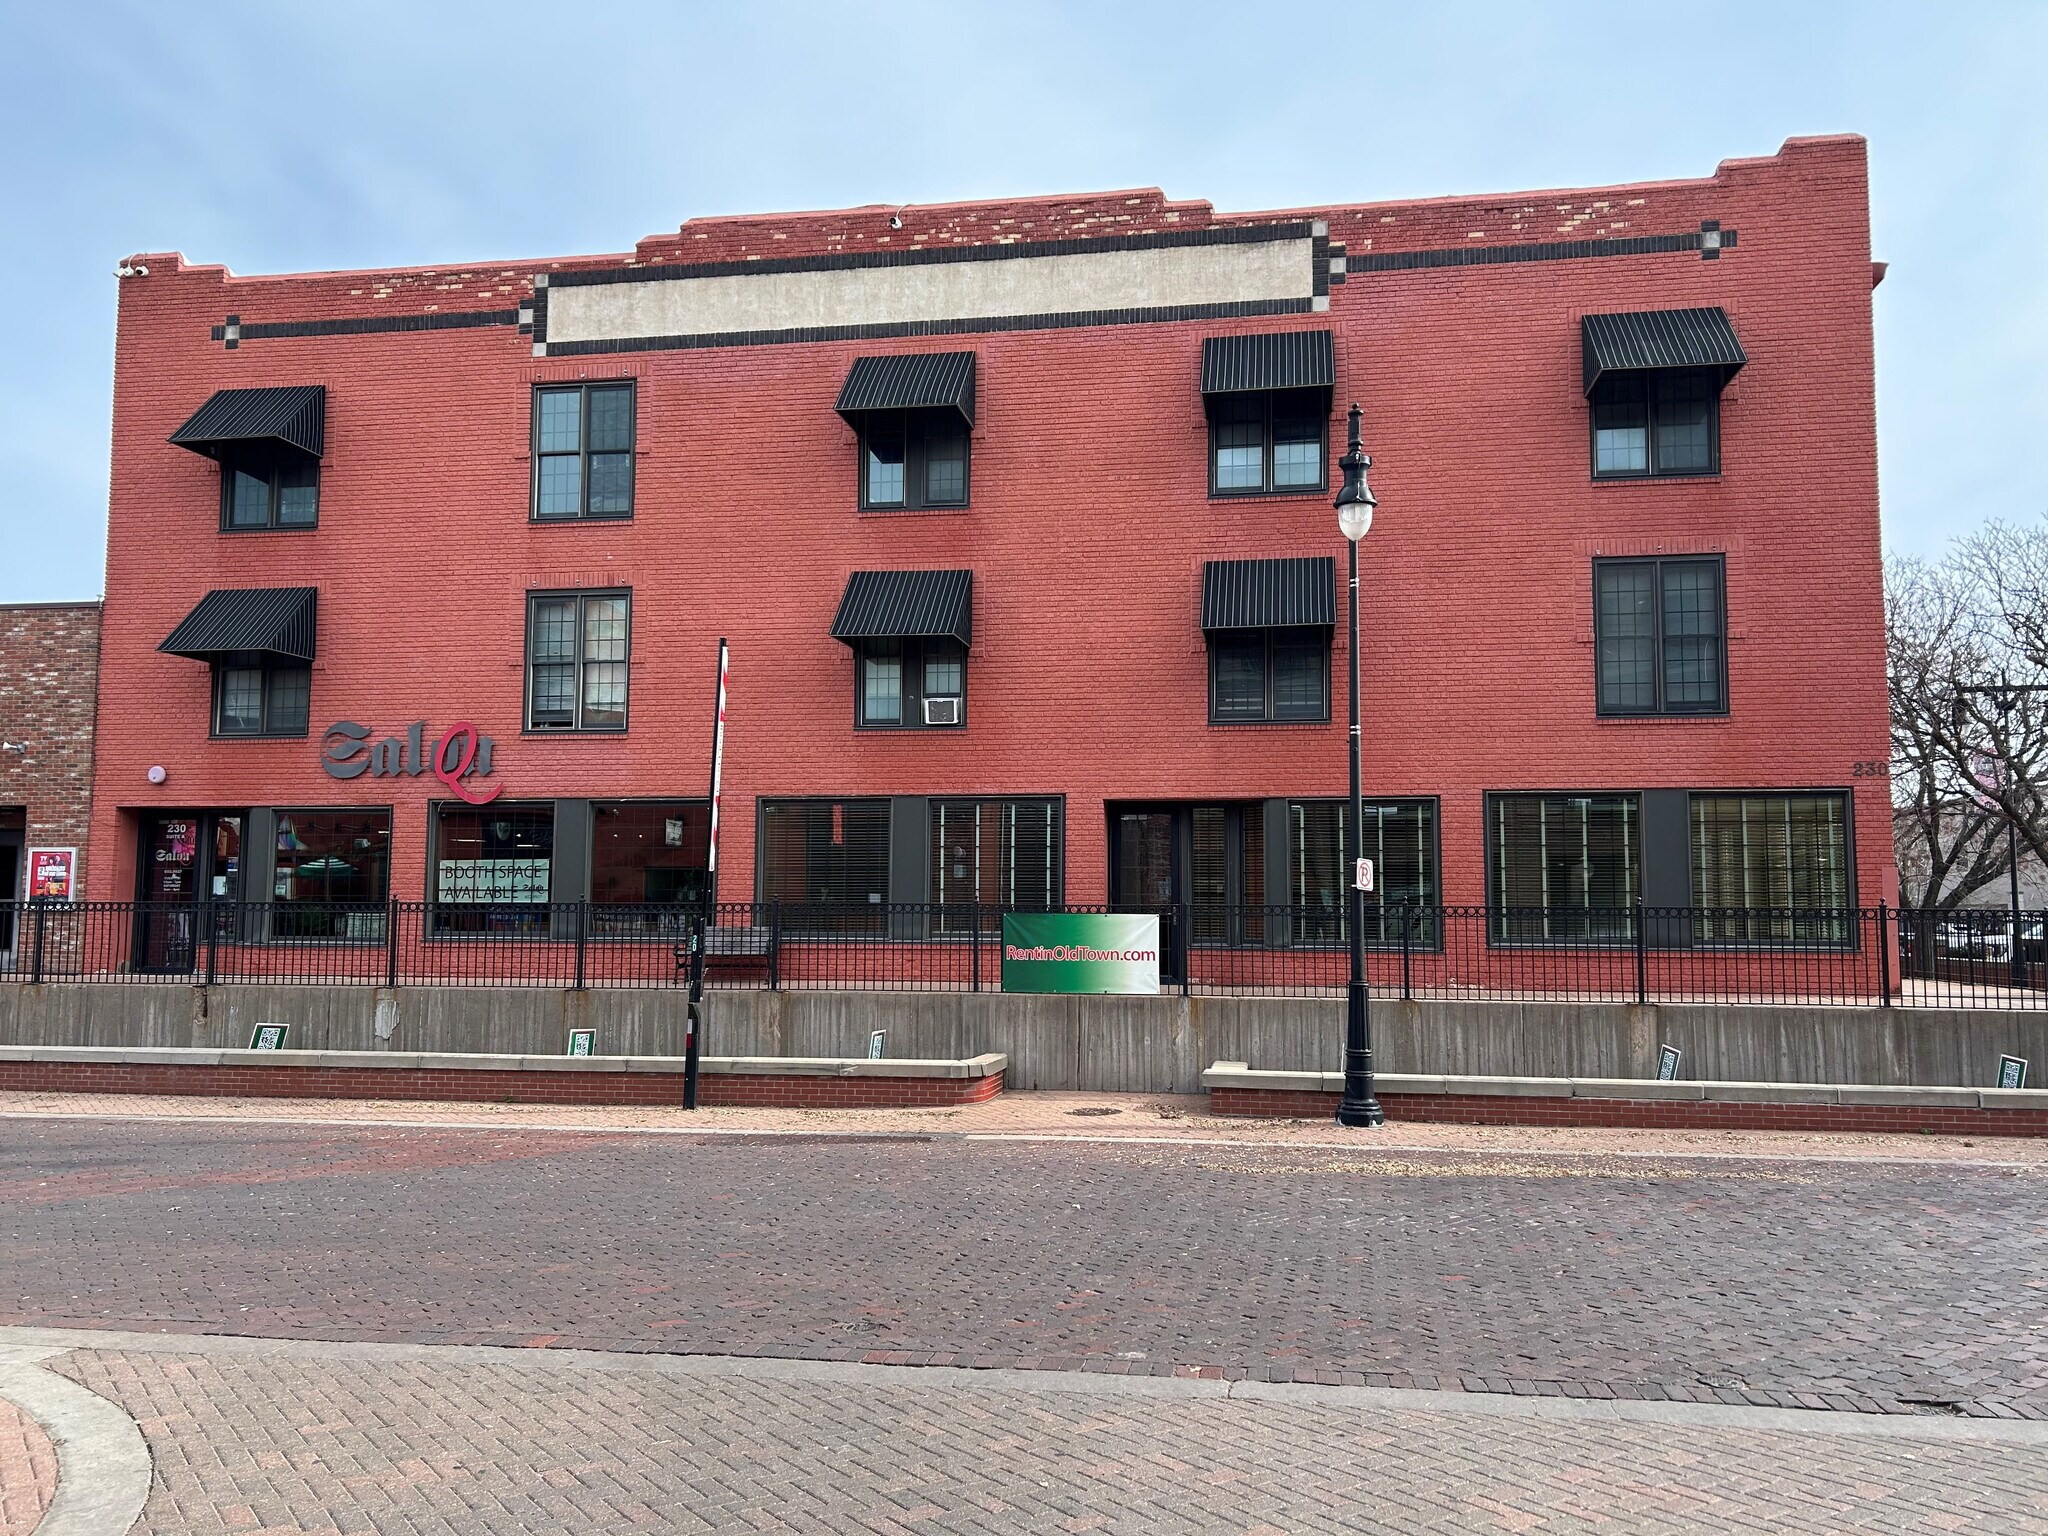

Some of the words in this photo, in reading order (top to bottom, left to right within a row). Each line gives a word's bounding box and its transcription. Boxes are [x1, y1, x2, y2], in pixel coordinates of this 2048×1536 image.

[1853, 762, 1888, 777] 230
[167, 824, 187, 833] 230
[445, 865, 494, 879] BOOTH
[499, 865, 542, 879] SPACE
[1006, 945, 1156, 961] RentinOldTown.com
